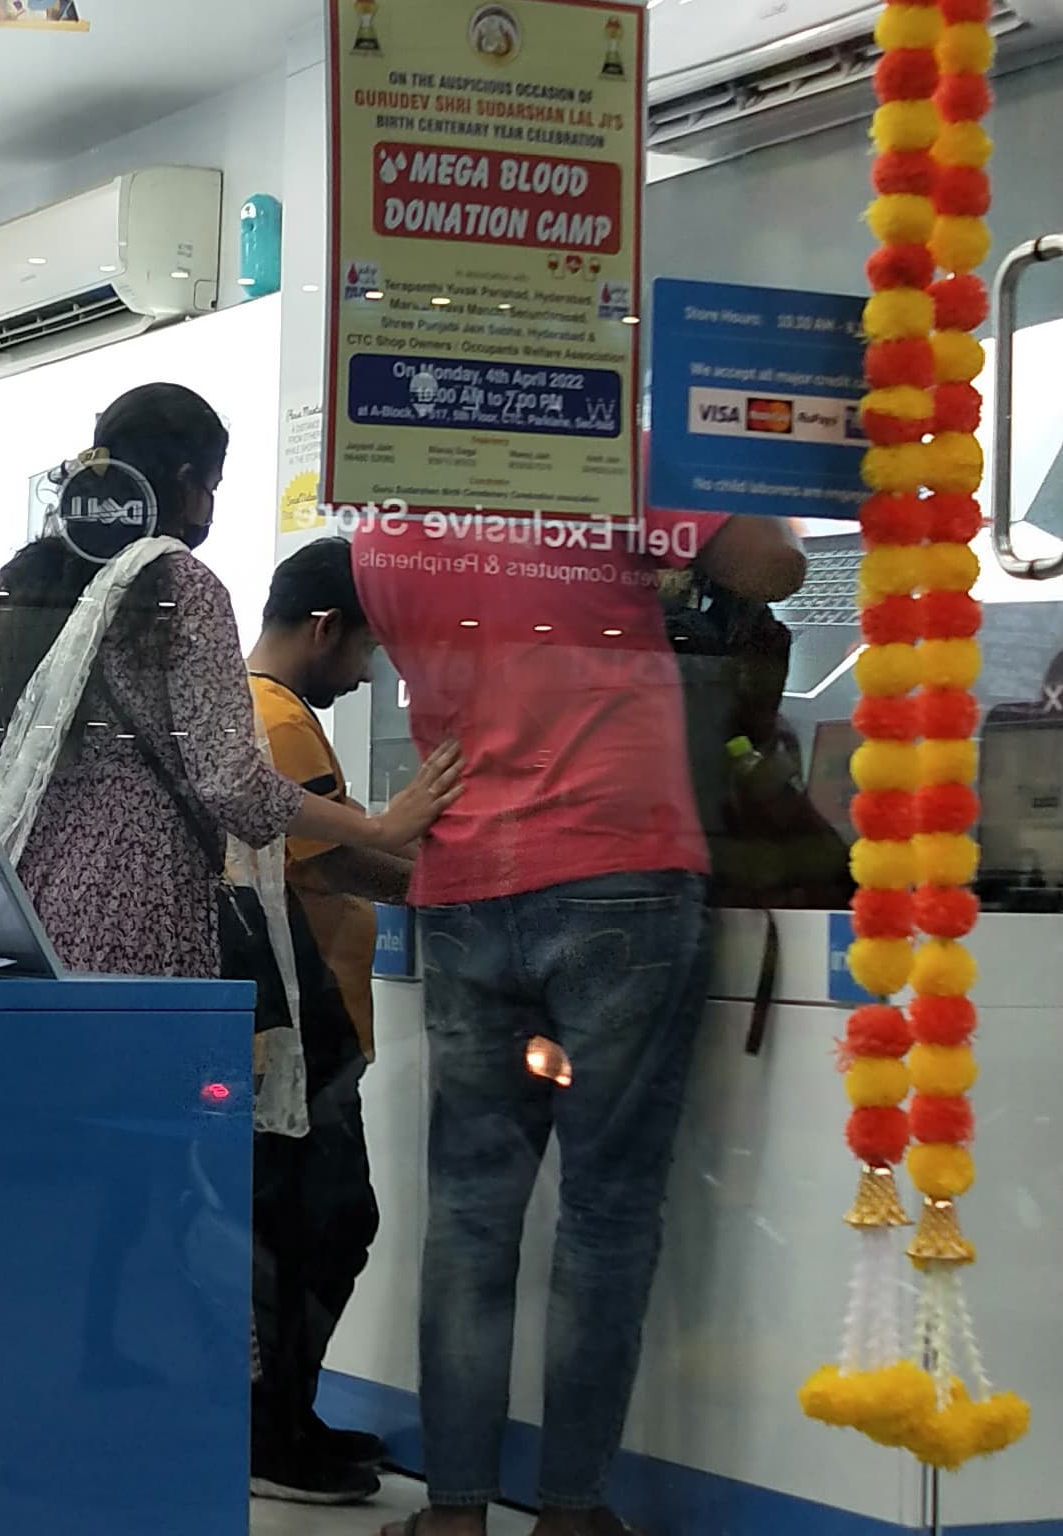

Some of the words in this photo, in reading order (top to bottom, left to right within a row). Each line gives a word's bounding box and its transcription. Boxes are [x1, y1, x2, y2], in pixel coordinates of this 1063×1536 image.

[389, 71, 407, 85] ON
[412, 73, 434, 88] THE
[439, 75, 513, 95] AUSPICIOUS
[516, 82, 575, 100] OCCASION
[578, 89, 593, 104] OF
[354, 90, 430, 111] GURUDEV
[435, 96, 471, 113] SHRI
[477, 99, 565, 122] SUDARSHAN
[568, 109, 594, 127] LAL
[376, 115, 414, 130] BIRTH
[418, 118, 489, 137] CENTENARY
[494, 124, 523, 140] YEAR
[527, 127, 605, 148] CELEBRATION
[409, 151, 489, 187] MEGA
[499, 159, 588, 197] BLOOD
[383, 197, 529, 239] DONATION
[536, 210, 612, 246] CAMP
[346, 333, 373, 346] CTC
[375, 335, 406, 349] Shop
[393, 362, 416, 378] On
[486, 368, 510, 384] 4th
[511, 369, 547, 388] April
[549, 372, 585, 390] 2022
[699, 404, 740, 423] VISA
[375, 928, 404, 952] ntel
